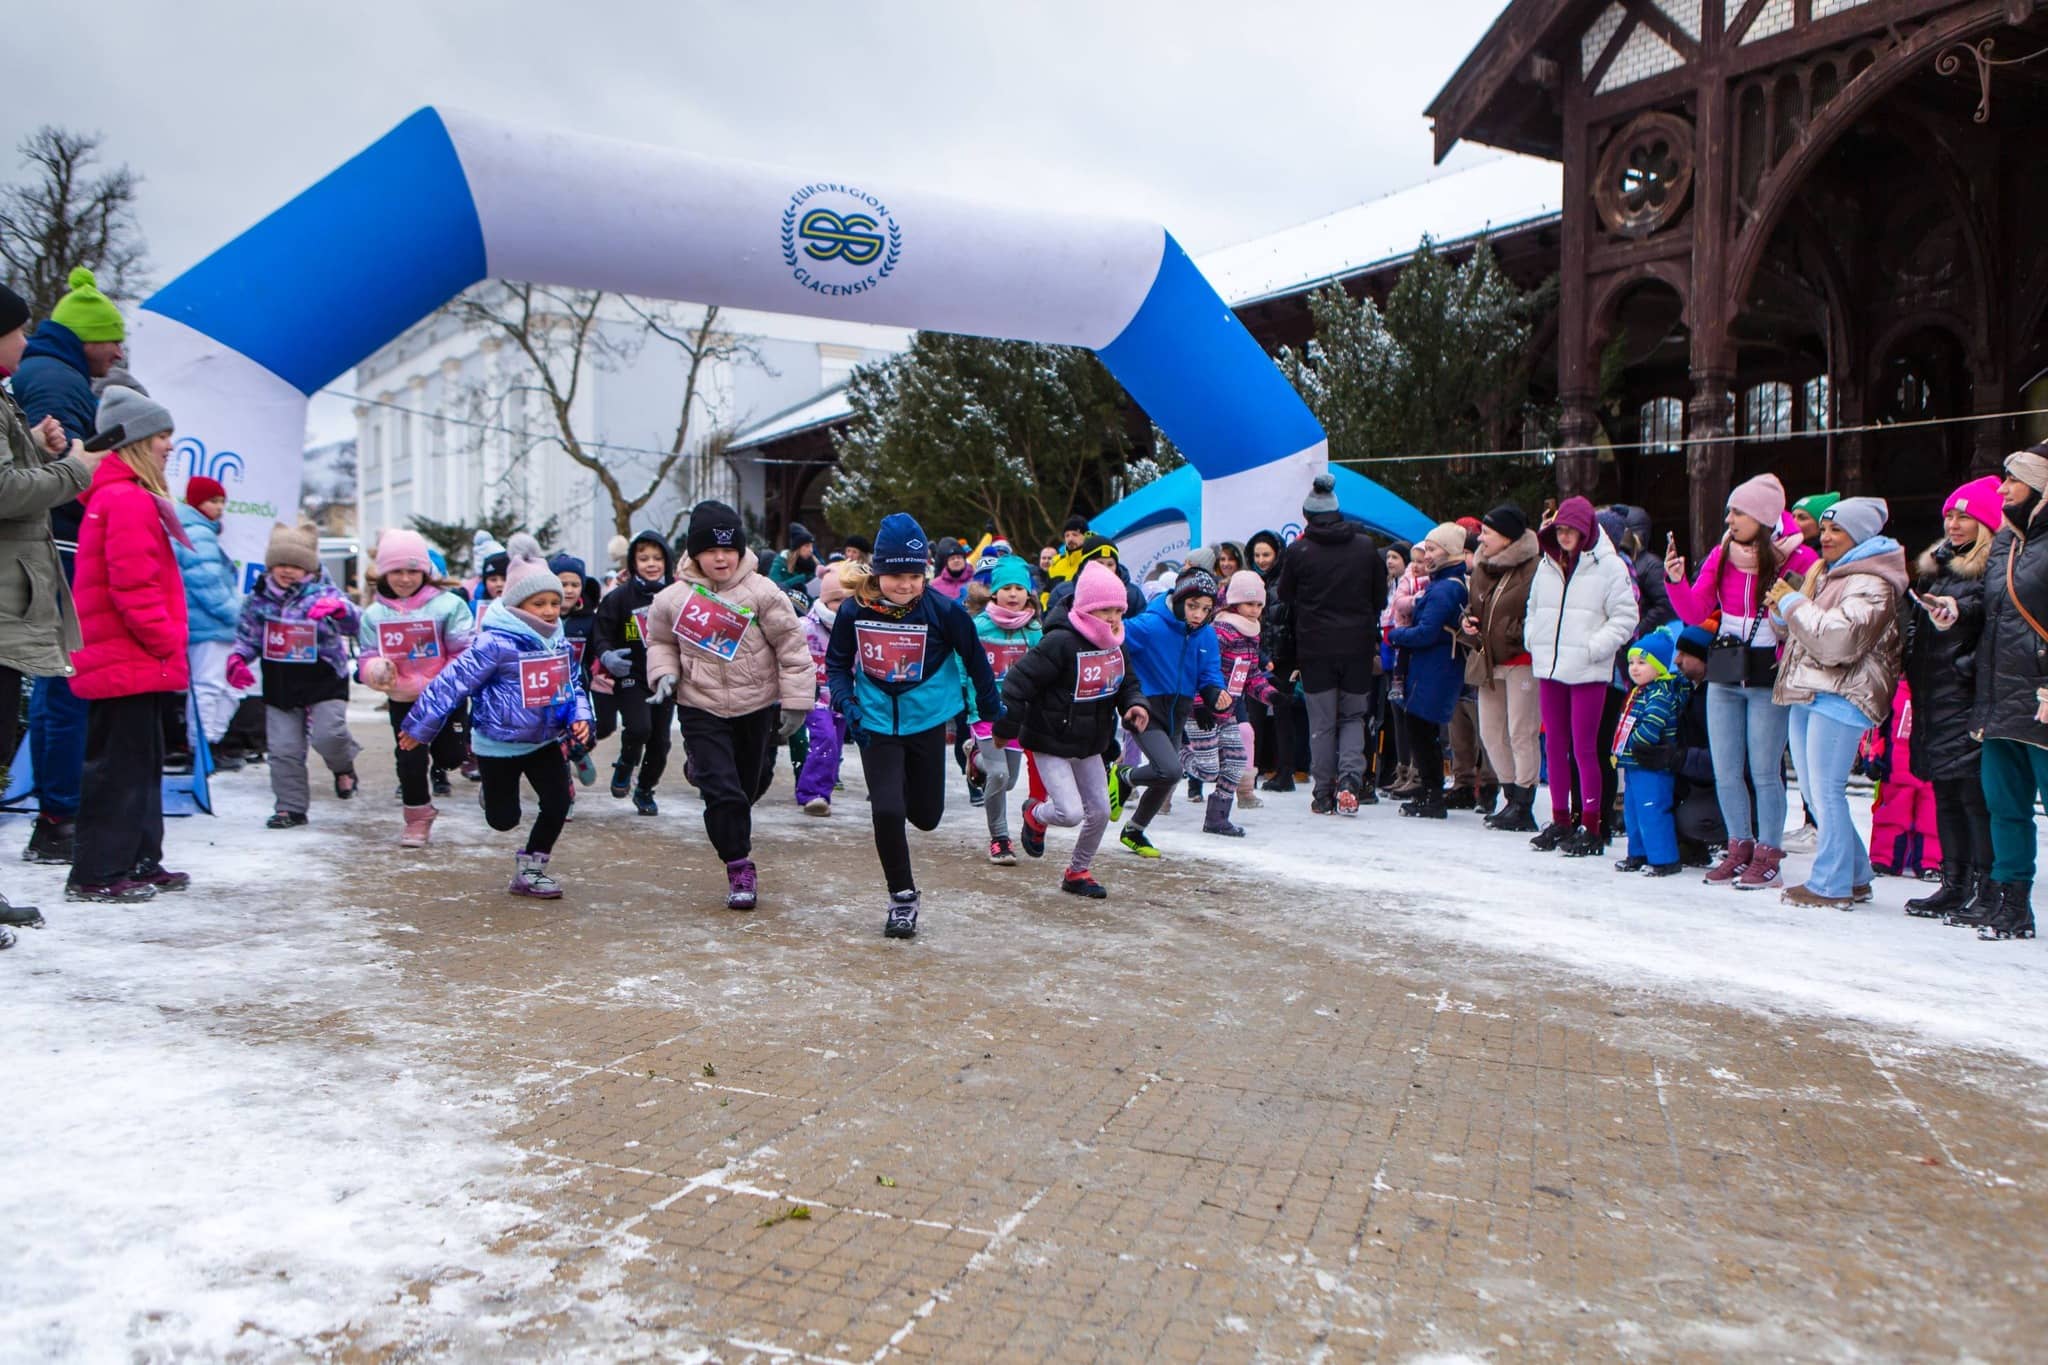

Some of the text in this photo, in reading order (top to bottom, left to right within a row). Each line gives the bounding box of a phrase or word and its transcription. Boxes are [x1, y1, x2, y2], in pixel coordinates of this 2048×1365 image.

[791, 183, 889, 217] EUROREGION
[794, 268, 877, 296] GLACENSIS
[226, 500, 278, 517] ZDRÓJ
[686, 605, 711, 626] 24
[384, 632, 404, 647] 29
[863, 642, 885, 661] 31
[527, 671, 550, 689] 15
[1083, 666, 1102, 682] 32
